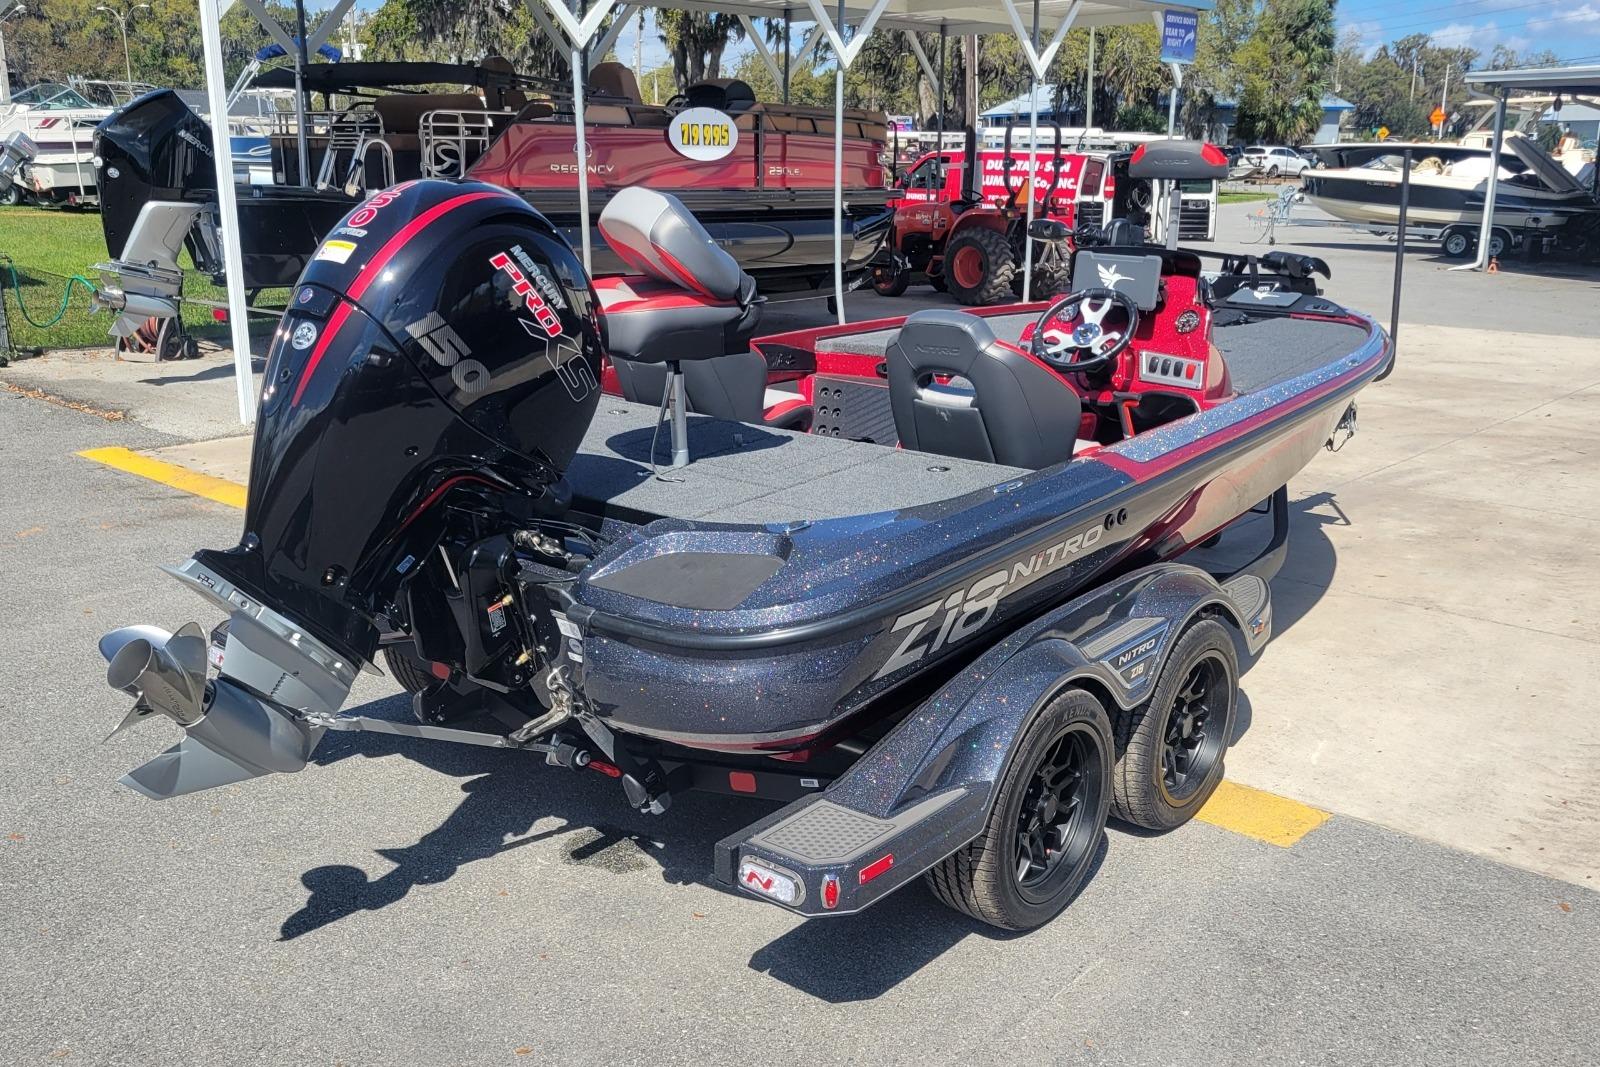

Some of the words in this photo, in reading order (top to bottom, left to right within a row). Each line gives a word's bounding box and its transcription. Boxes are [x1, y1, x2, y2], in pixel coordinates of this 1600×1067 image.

[1165, 27, 1178, 37] BEAR
[1179, 29, 1186, 38] TO
[1166, 37, 1182, 47] RIGHT
[177, 129, 215, 159] MERCUR
[550, 163, 615, 175] REGNCY
[1043, 161, 1071, 173] SN
[510, 244, 568, 310] MERCURY
[488, 251, 563, 338] PRO
[404, 310, 492, 393] 150
[871, 569, 1010, 682] Z18
[1008, 524, 1104, 585] NITRO
[1118, 638, 1156, 666] NITRO
